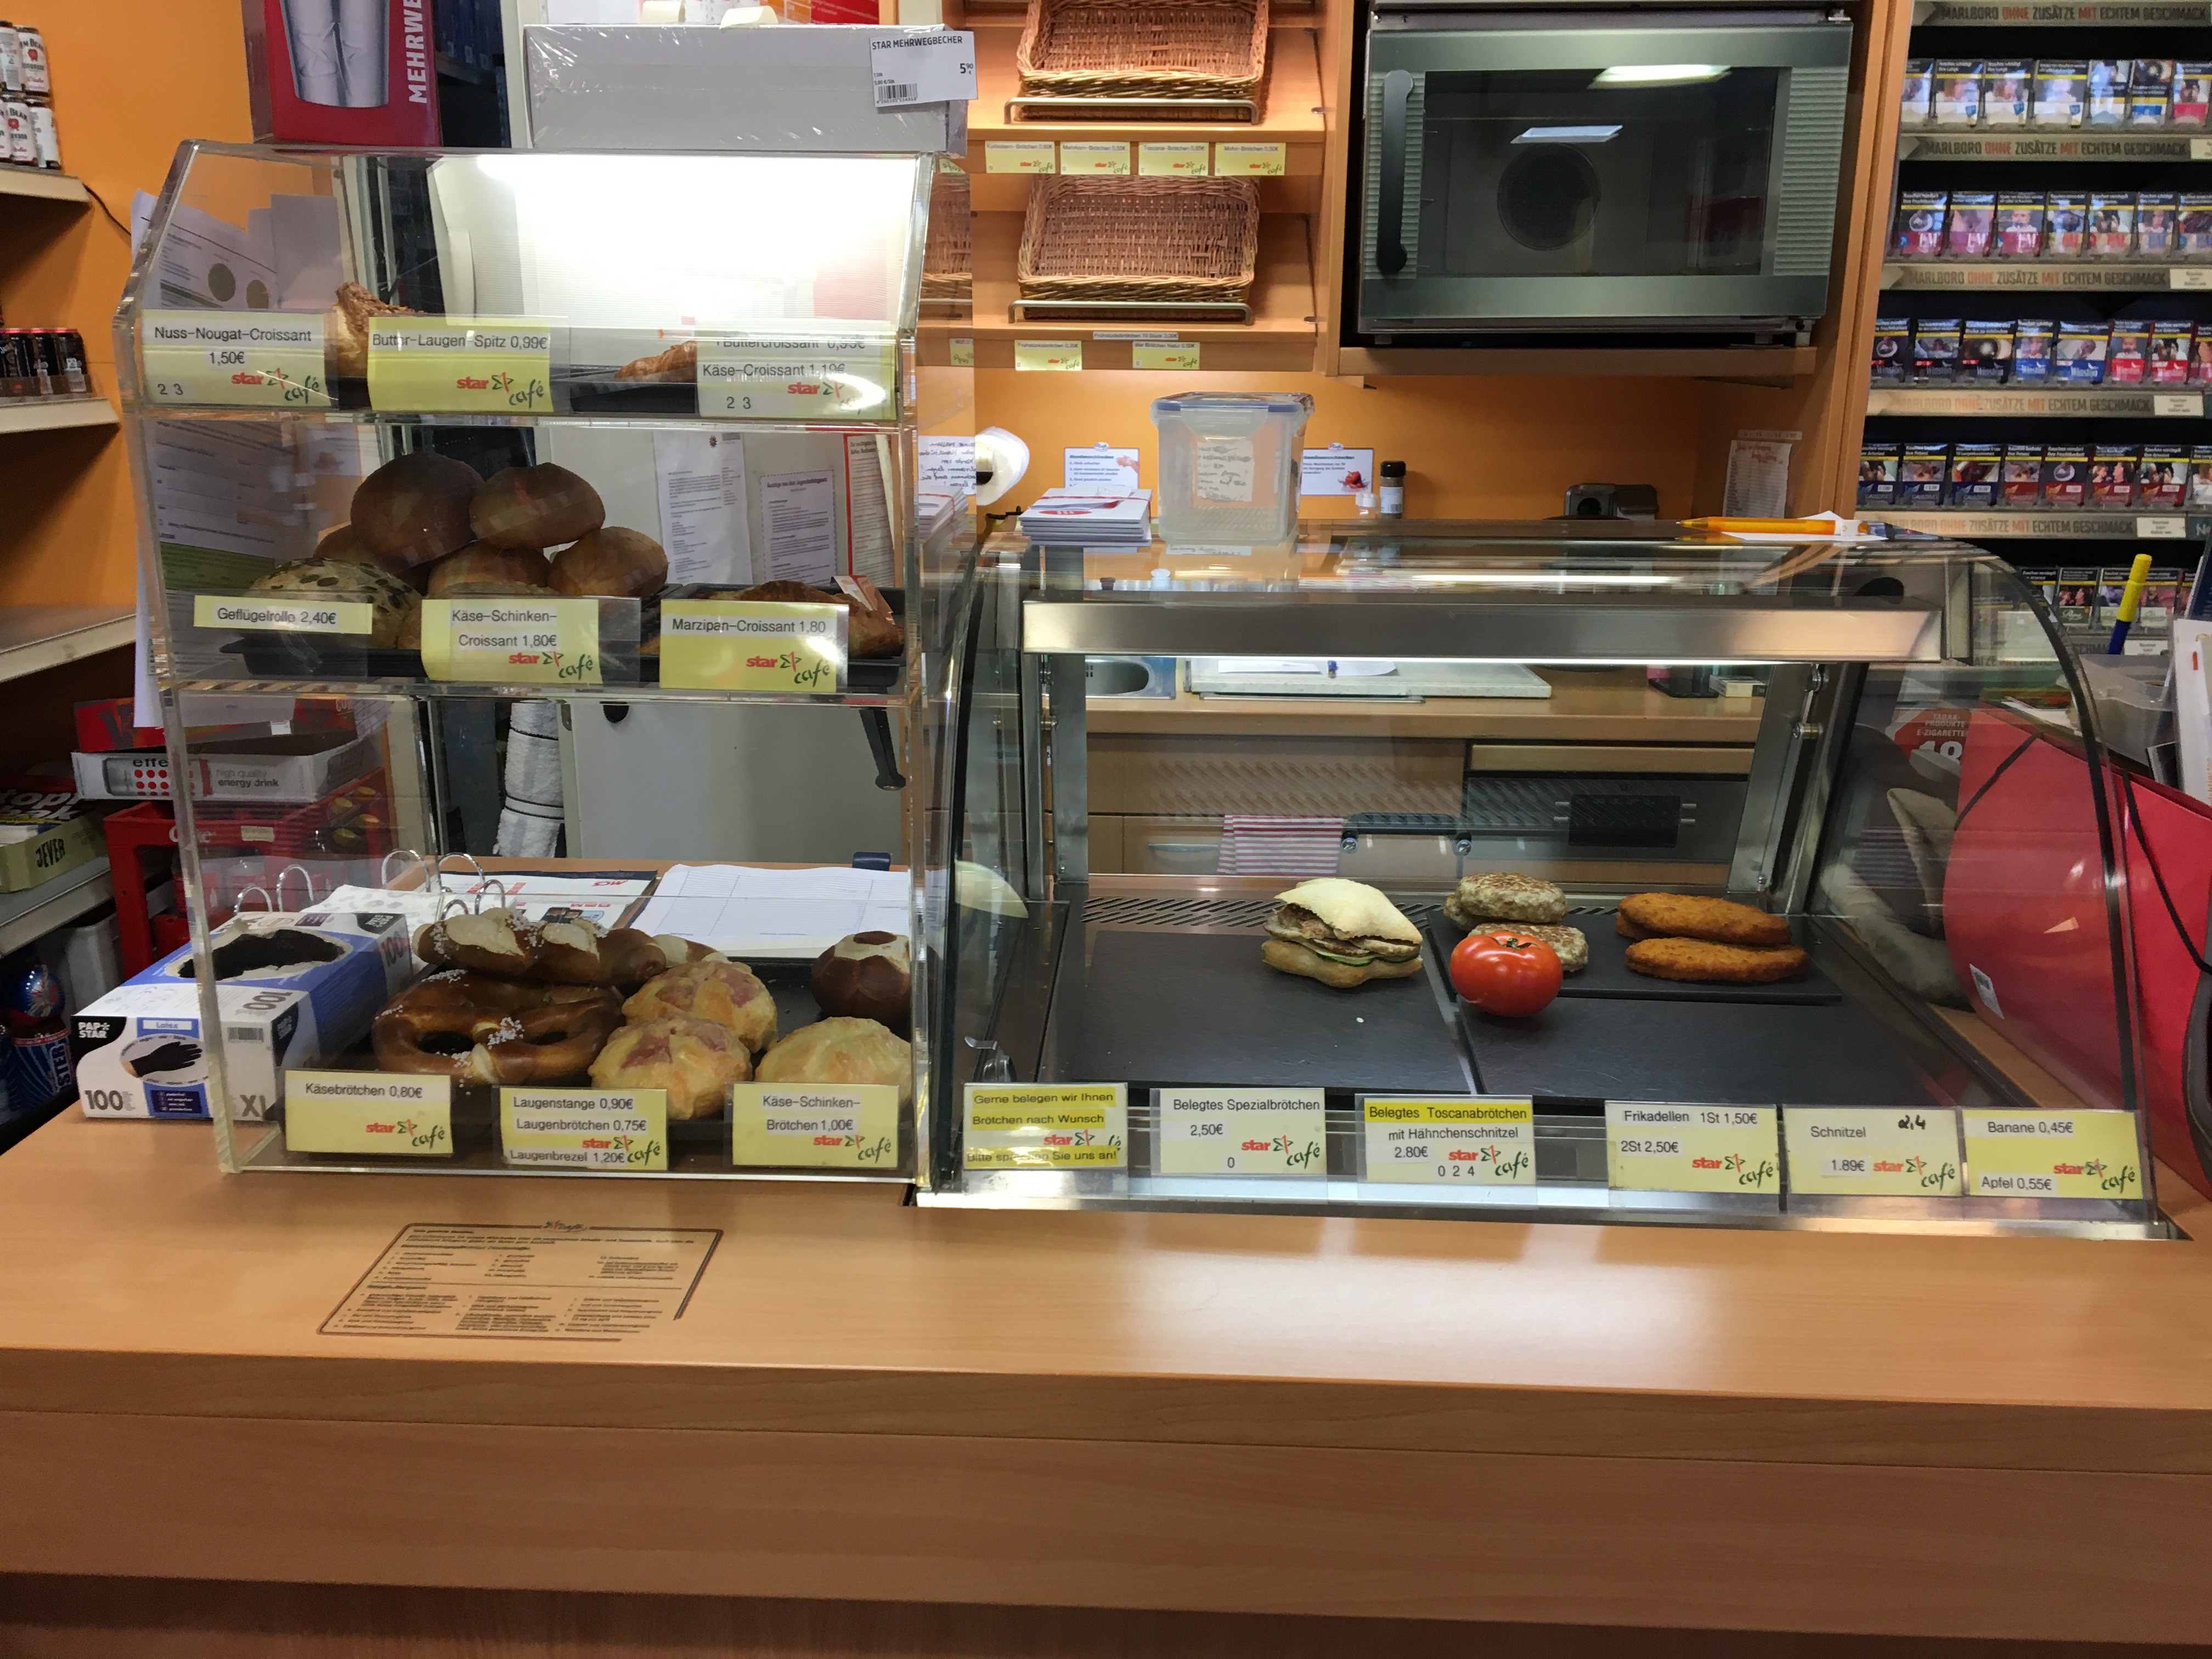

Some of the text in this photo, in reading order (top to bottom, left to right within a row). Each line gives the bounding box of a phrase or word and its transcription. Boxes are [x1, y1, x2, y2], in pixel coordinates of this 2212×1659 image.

[2002, 6, 2028, 19] OHNE
[2033, 5, 2075, 20] ZUSÄTZE
[2078, 7, 2096, 19] MIT
[2100, 7, 2138, 19] ECHTEM
[2143, 7, 2206, 20] GESCHMACK
[872, 36, 963, 49] STAR MEHRWEGBECHER
[1985, 142, 2011, 154] OHNE
[2015, 139, 2057, 154] ZUSÄTZE
[2061, 142, 2078, 154] MIT
[2081, 142, 2121, 154] ECHTEM
[2124, 142, 2187, 155] GESCHMACK
[1967, 272, 1993, 284] OHNE
[1997, 269, 2038, 284] ZUSÄTZE
[2041, 272, 2060, 284] MIT
[2063, 272, 2101, 284] ECHTEM
[2105, 272, 2166, 285] GESCHMACK
[155, 327, 311, 342] Nuss-Nougat-Croissant
[373, 334, 548, 350] Butter-Laugen-Spitz 0,99€
[209, 352, 245, 366] 1,50€
[703, 362, 805, 377] Käse-Croissant
[232, 372, 263, 385] star
[456, 376, 489, 390] star
[157, 383, 184, 396] 2 3
[284, 376, 320, 404] café
[509, 378, 545, 407] café
[787, 382, 820, 396] star
[726, 396, 752, 409] 2 3
[1954, 397, 1981, 410] OHNE
[1983, 396, 2024, 410] ZUSÄTZE
[2028, 398, 2046, 410] MIT
[2049, 398, 2087, 410] ECHTEM
[2090, 398, 2151, 411] GESCHMACK
[1941, 519, 1966, 532] OHNE
[1969, 517, 2010, 532] ZUSÄTZE
[2012, 520, 2030, 532] MIT
[2033, 520, 2072, 532] ECHTEM
[2074, 520, 2133, 533] GESCHMACK
[300, 611, 337, 626] 2,40€
[452, 610, 557, 623] Käse-Schinken-
[672, 618, 826, 634] Marzipan-Croissant 1,80
[458, 634, 558, 648] Croissant 1,80€
[508, 652, 540, 665] star
[746, 655, 778, 669] star
[558, 653, 594, 680] café
[793, 659, 831, 687] café
[218, 778, 279, 788] energy drink
[35, 838, 66, 868] JEVER
[78, 1030, 108, 1039] STAR
[305, 1082, 423, 1099] Käsebrötchen 0,80€
[84, 1090, 123, 1111] 100
[514, 1097, 634, 1112] Laugenstange 0,90€
[763, 1095, 861, 1109] Käse-Schinken-
[1012, 1093, 1058, 1104] belegen
[1060, 1093, 1079, 1103] wir
[1081, 1092, 1113, 1102] Ihnen
[1173, 1098, 1321, 1113] Belegtes Spezialbrötchen
[1369, 1105, 1527, 1120] Belegtes Toscanabrötchen
[972, 1113, 1105, 1126] Brötchen nach Wunsch
[1624, 1110, 1758, 1125] Frikadellen 1St 1,50€
[365, 1122, 395, 1134] star
[516, 1118, 646, 1132] Laugenbrötchen 0,75€
[766, 1119, 854, 1132] Brötchen 1,00€
[1190, 1124, 1224, 1138] 2,50€
[1810, 1126, 1866, 1138] Schnitzel
[1988, 1121, 2073, 1135] Banane 0,45€
[411, 1124, 445, 1148] café
[813, 1135, 843, 1146] star
[1043, 1134, 1074, 1147] star
[1389, 1126, 1519, 1141] mit Hähnchenschnitzel
[582, 1137, 612, 1149] star
[1240, 1139, 1271, 1152] star
[1621, 1141, 1679, 1154] 2St 2,50€
[510, 1150, 625, 1165] Laugenbrezel 1,20€
[627, 1141, 661, 1166] café
[857, 1137, 892, 1164] café
[1052, 1150, 1070, 1161] Sie
[1074, 1152, 1094, 1160] uns
[1097, 1150, 1116, 1160] an!
[1286, 1142, 1321, 1170] café
[1394, 1146, 1429, 1159] 2.80€
[1448, 1149, 1479, 1161] star
[1227, 1157, 1235, 1169] 0
[1495, 1152, 1530, 1180] café
[1691, 1158, 1722, 1170] star
[1831, 1159, 1865, 1172] 1.89€
[1873, 1160, 1904, 1173] star
[2053, 1163, 2085, 1176] star
[1438, 1166, 1476, 1177] 0 2 4
[1739, 1158, 1774, 1187] café
[1921, 1163, 1956, 1191] café
[1982, 1177, 2052, 1192] Apfel 0,55€
[2101, 1166, 2136, 1194] café
